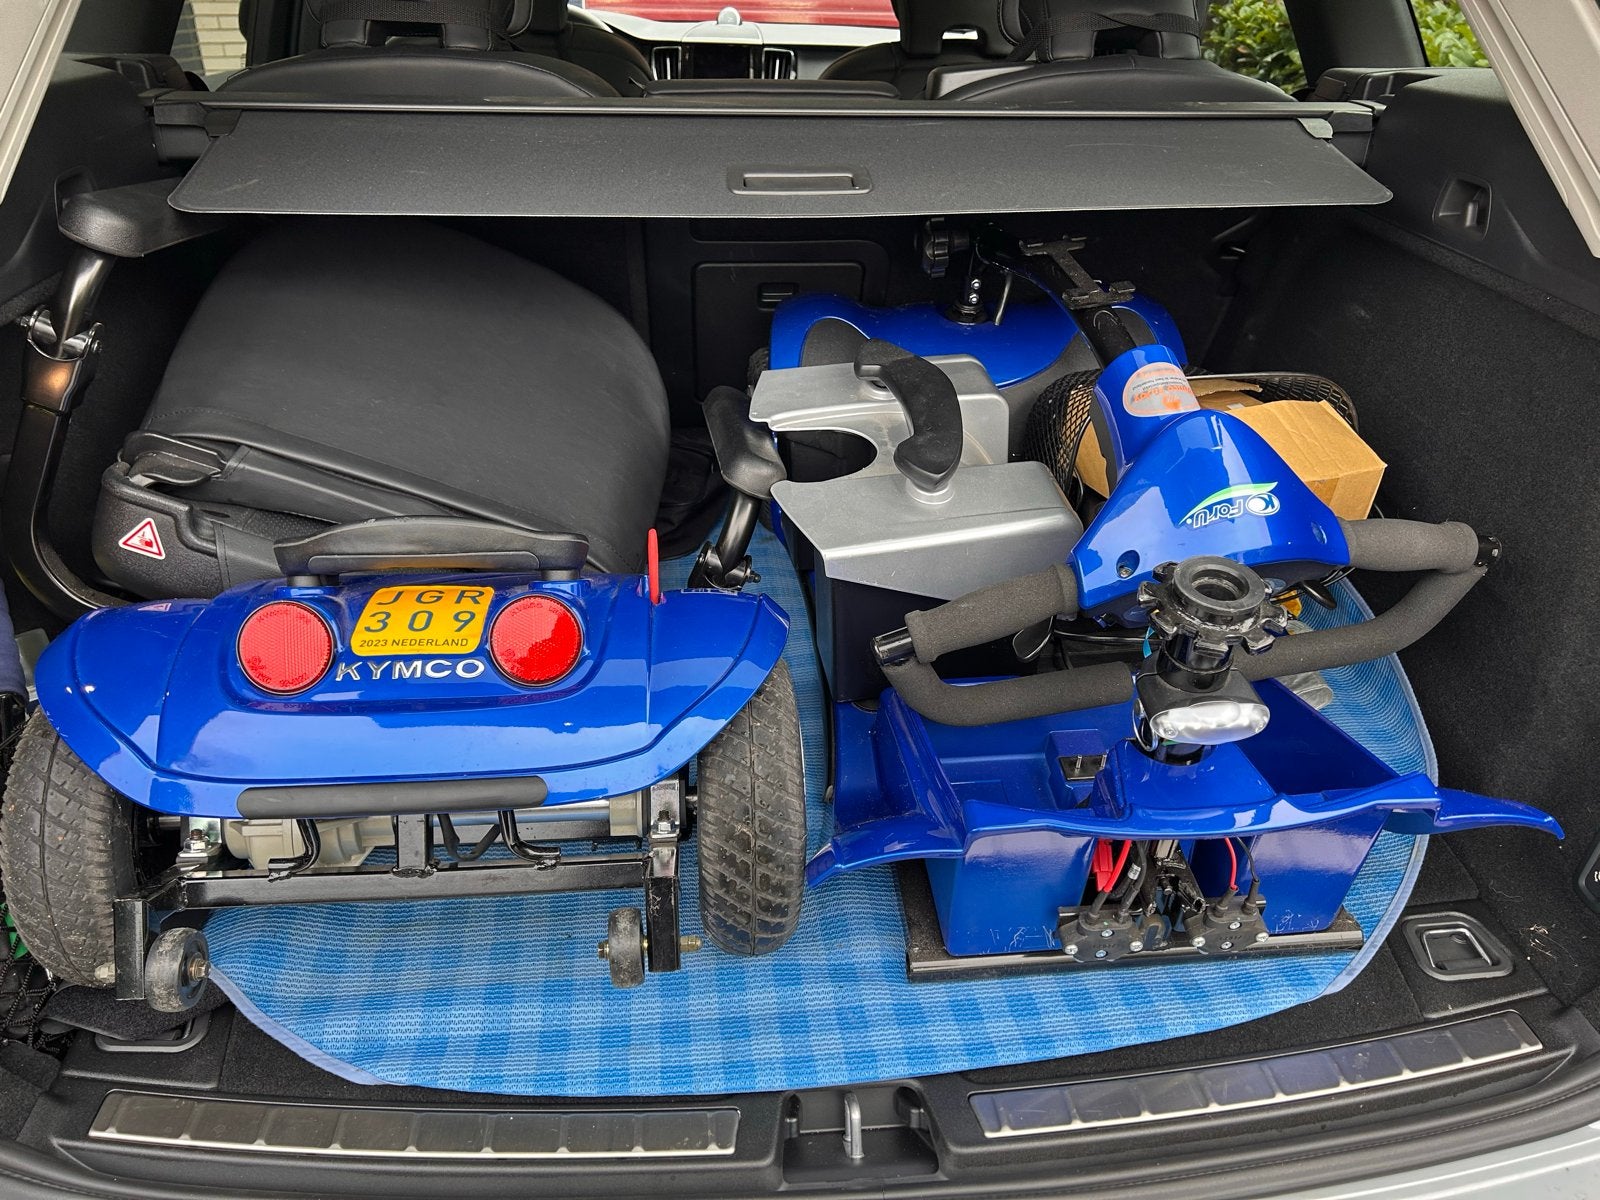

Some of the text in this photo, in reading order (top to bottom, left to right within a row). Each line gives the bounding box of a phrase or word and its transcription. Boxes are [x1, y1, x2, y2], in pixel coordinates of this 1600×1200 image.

[376, 589, 485, 606] JGR
[364, 610, 476, 633] 309
[359, 638, 469, 648] 2023 NEDERLAND
[335, 659, 485, 682] KYMCO
